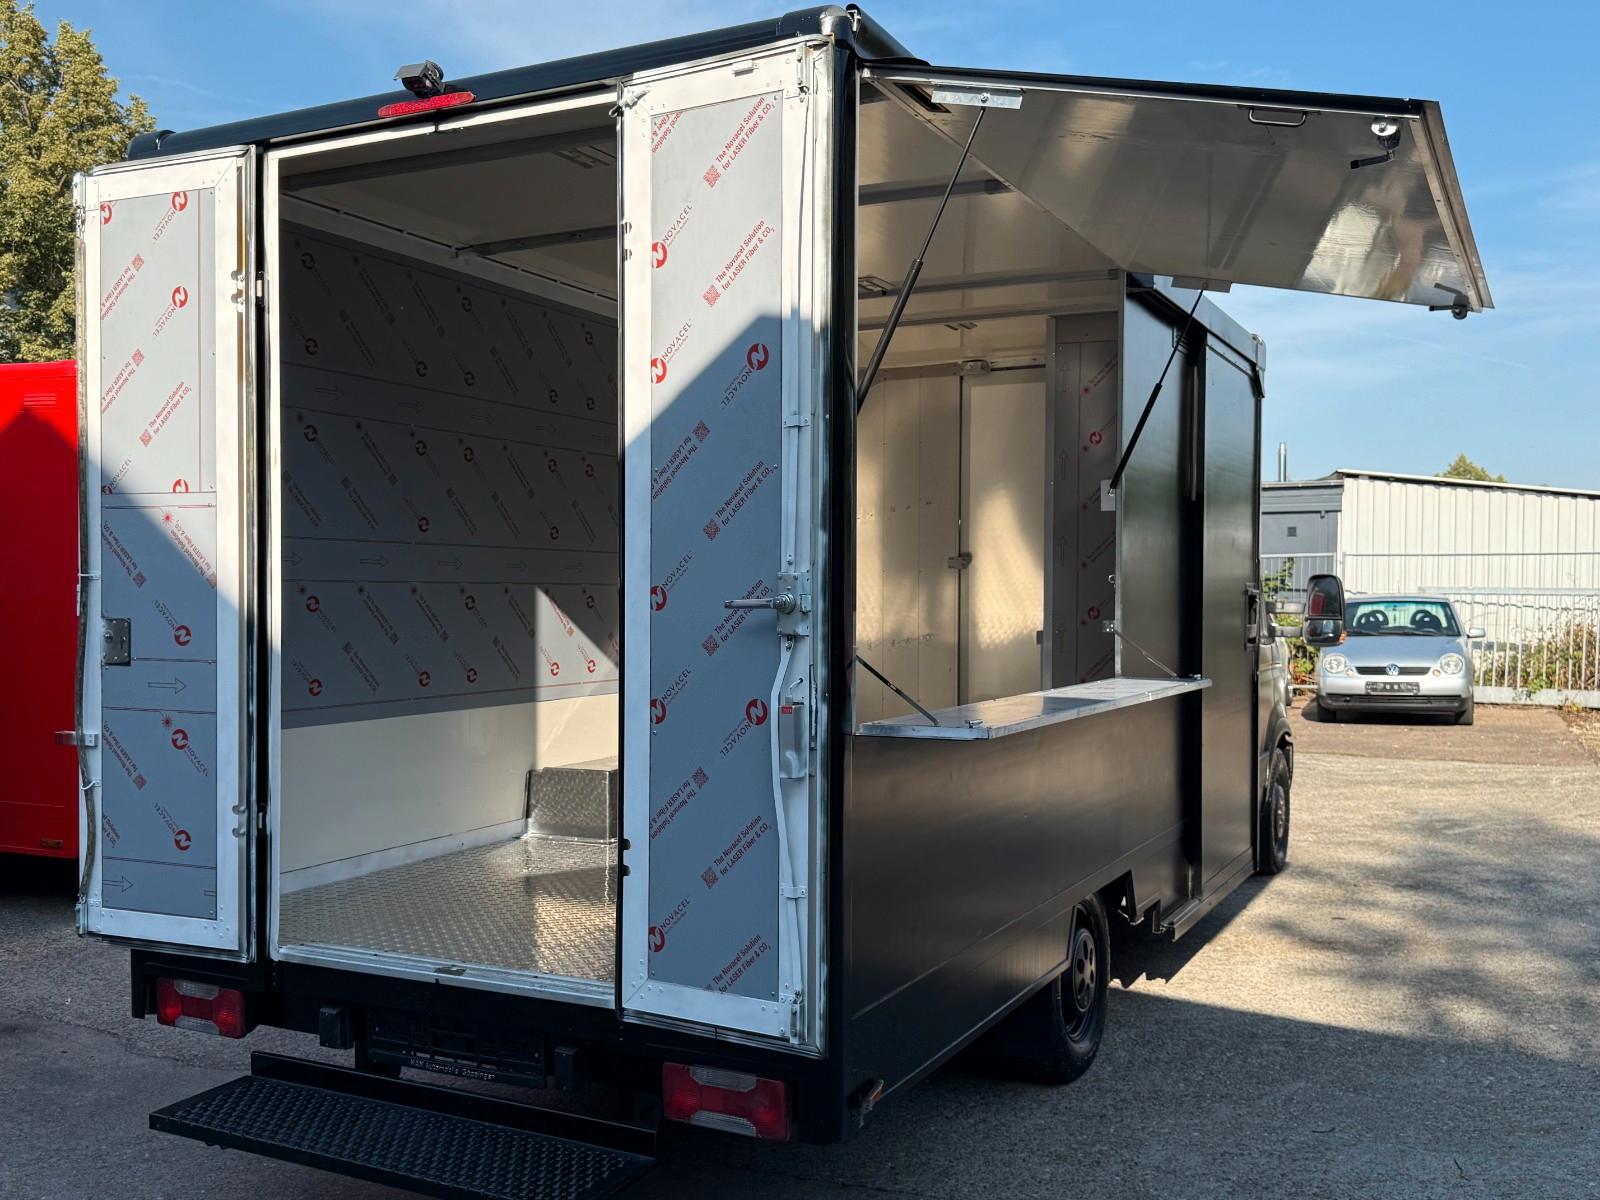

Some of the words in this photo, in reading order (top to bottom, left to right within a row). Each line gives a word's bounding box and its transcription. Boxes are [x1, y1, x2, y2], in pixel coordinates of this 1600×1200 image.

[651, 126, 671, 153] Solution
[724, 122, 745, 151] Novacel
[743, 96, 764, 125] Solution
[729, 137, 747, 160] LASER
[744, 120, 759, 139] Fiber
[152, 209, 176, 240] NOVACEL
[662, 205, 692, 243] NOVACEL
[724, 244, 745, 271] Novacel
[743, 220, 764, 247] Solution
[728, 258, 747, 281] LASER
[744, 242, 758, 260] Fiber
[152, 305, 176, 336] NOVACEL
[661, 322, 691, 360] NOVACEL
[720, 367, 752, 405] NOVACEL
[667, 444, 685, 465] LASER
[669, 453, 689, 478] Novacel
[723, 482, 744, 508] Novacel
[742, 460, 764, 485] Solution
[728, 496, 746, 518] LASER
[743, 482, 758, 499] Fiber
[661, 554, 692, 589] NOVACEL
[727, 613, 745, 634] LASER
[660, 668, 691, 702] NOVACEL
[719, 721, 751, 756] NOVACEL
[666, 787, 684, 807] LASER
[668, 797, 688, 820] Novacel
[722, 834, 742, 857] Novacel
[740, 815, 762, 838] Solution
[726, 848, 744, 868] LASER
[741, 835, 756, 851] Fiber
[659, 898, 690, 931] NOVACEL
[721, 952, 742, 976] Novacel
[739, 934, 761, 956] Solution
[725, 967, 743, 986] LASER
